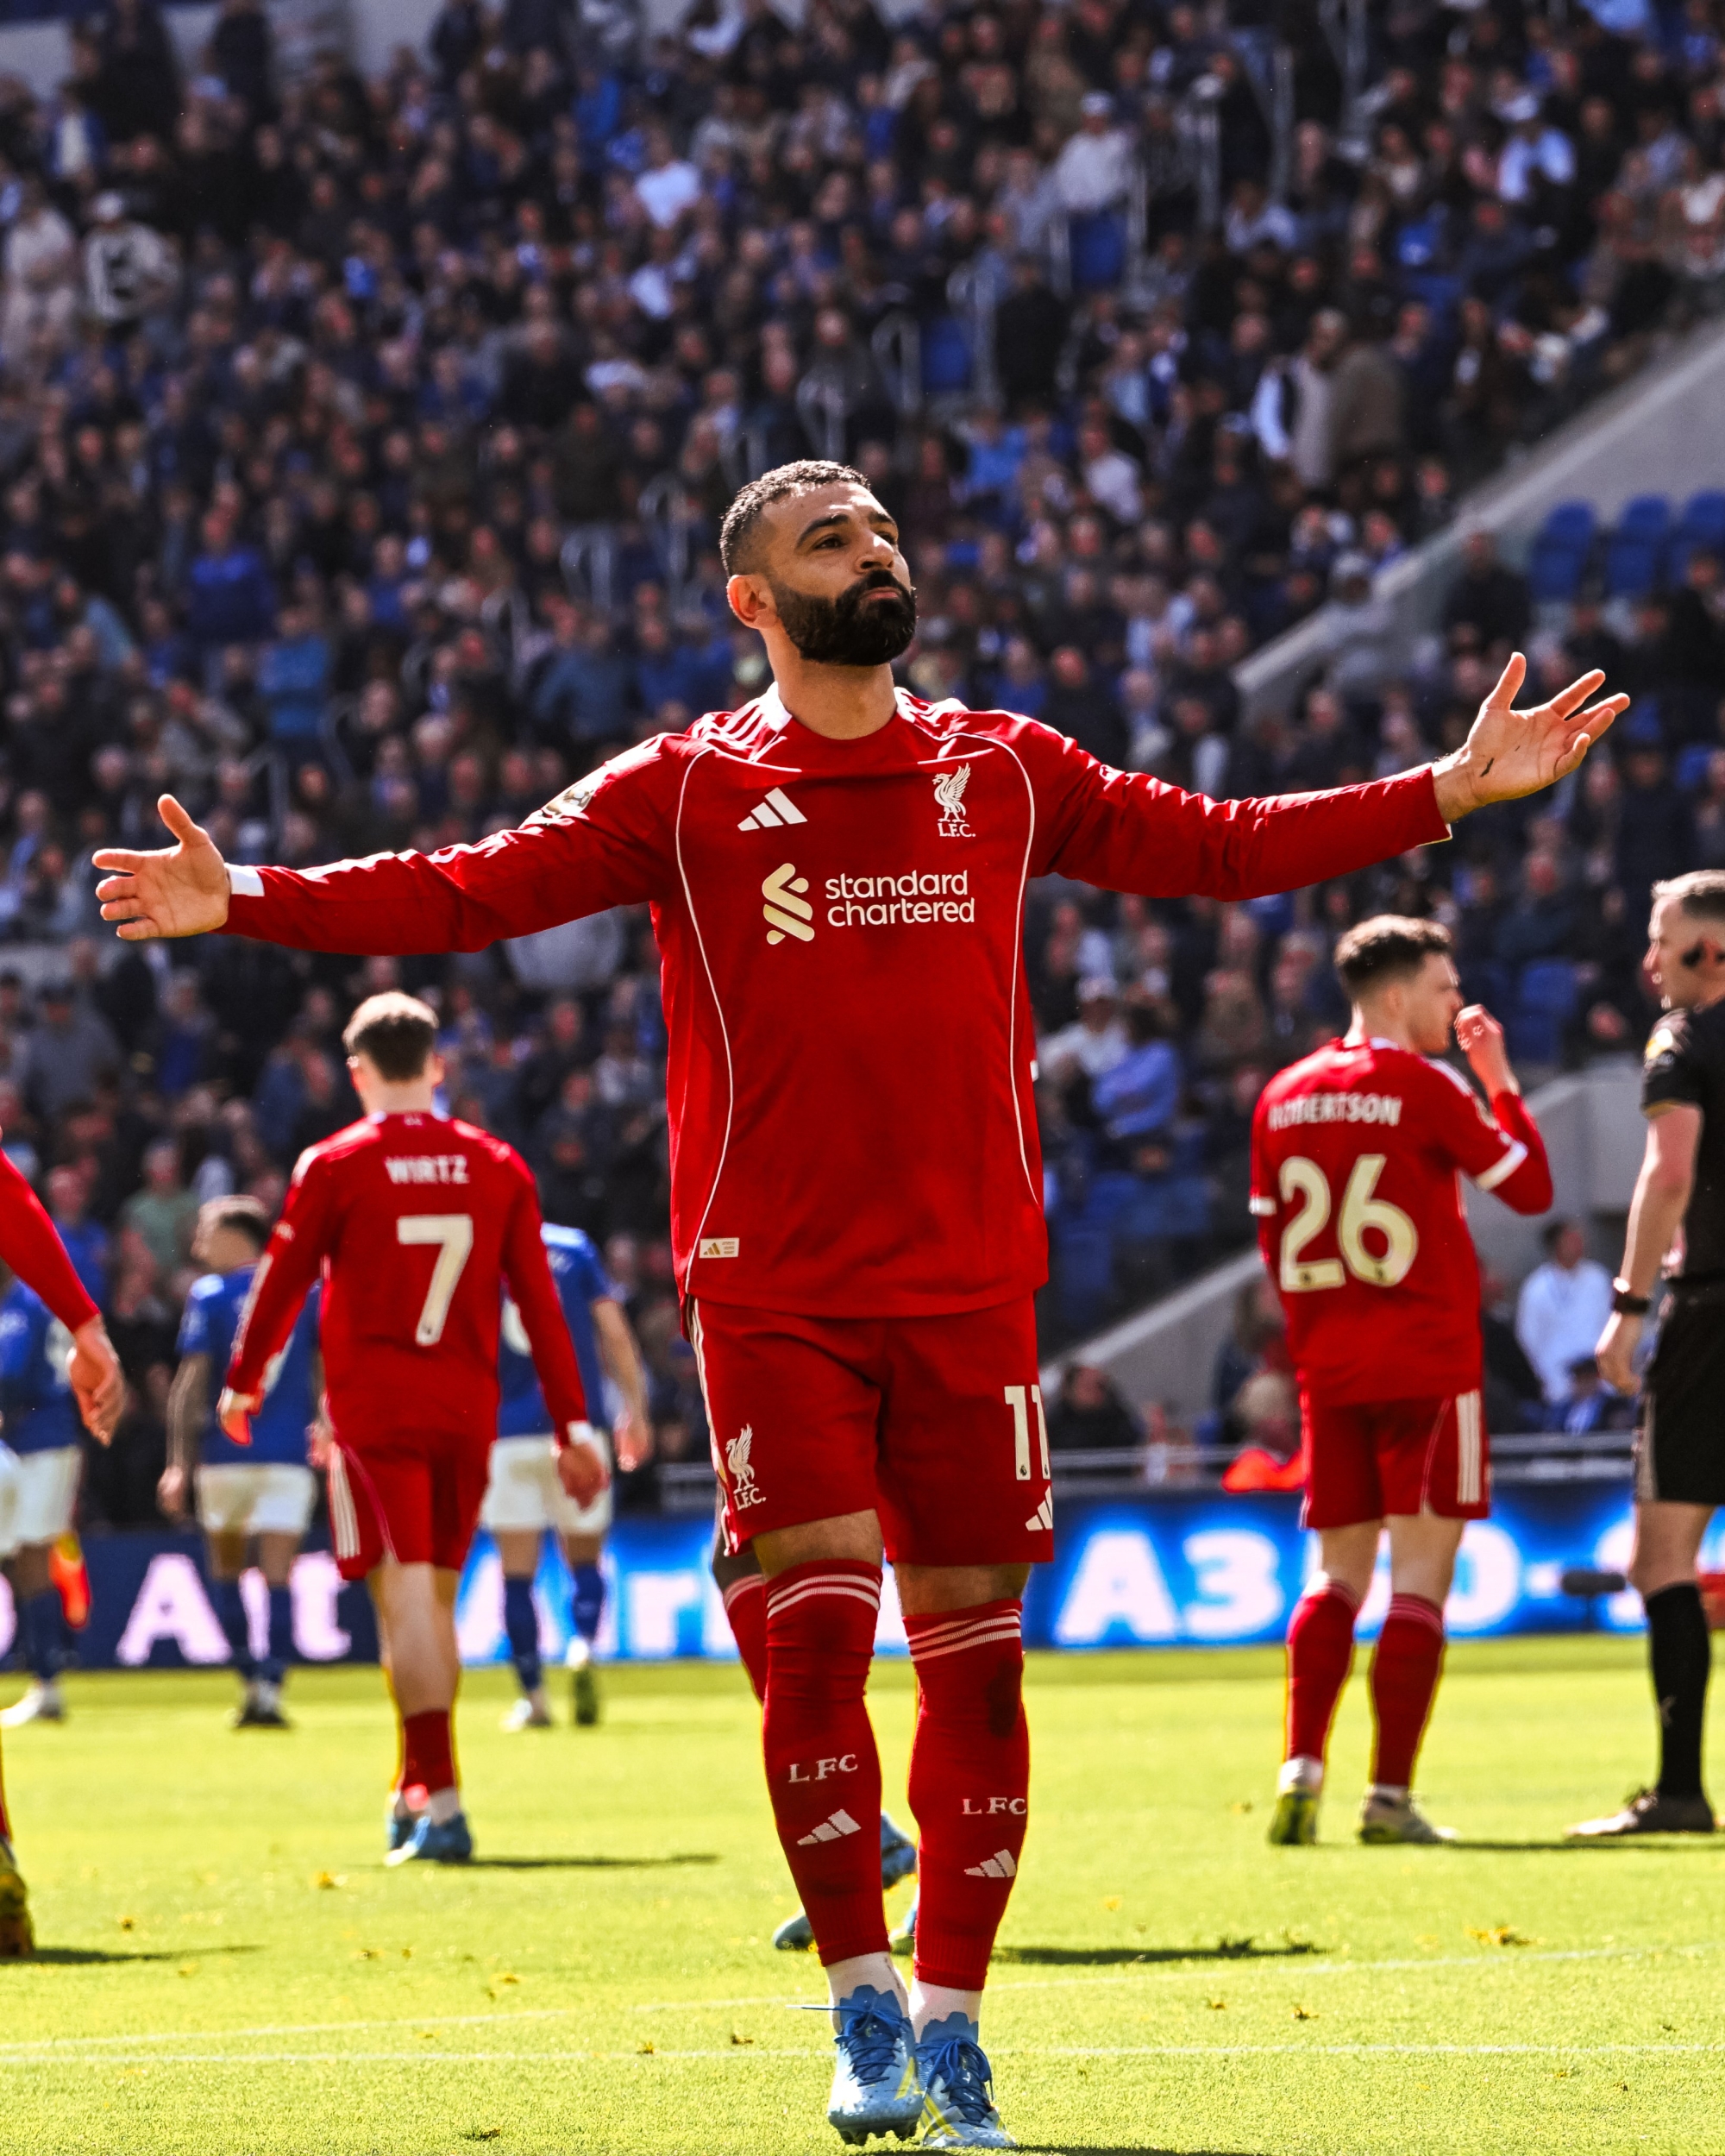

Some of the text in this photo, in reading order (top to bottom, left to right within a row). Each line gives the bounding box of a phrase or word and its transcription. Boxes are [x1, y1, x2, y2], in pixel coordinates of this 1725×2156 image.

[825, 870, 968, 900] standard
[826, 897, 975, 927] chartered
[384, 1153, 471, 1185] WIRTZ
[1278, 1153, 1420, 1292] 26
[396, 1212, 474, 1348] 7
[1003, 1384, 1051, 1480] 11
[787, 1752, 859, 1784] LFC
[961, 1796, 1027, 1816] LFC
